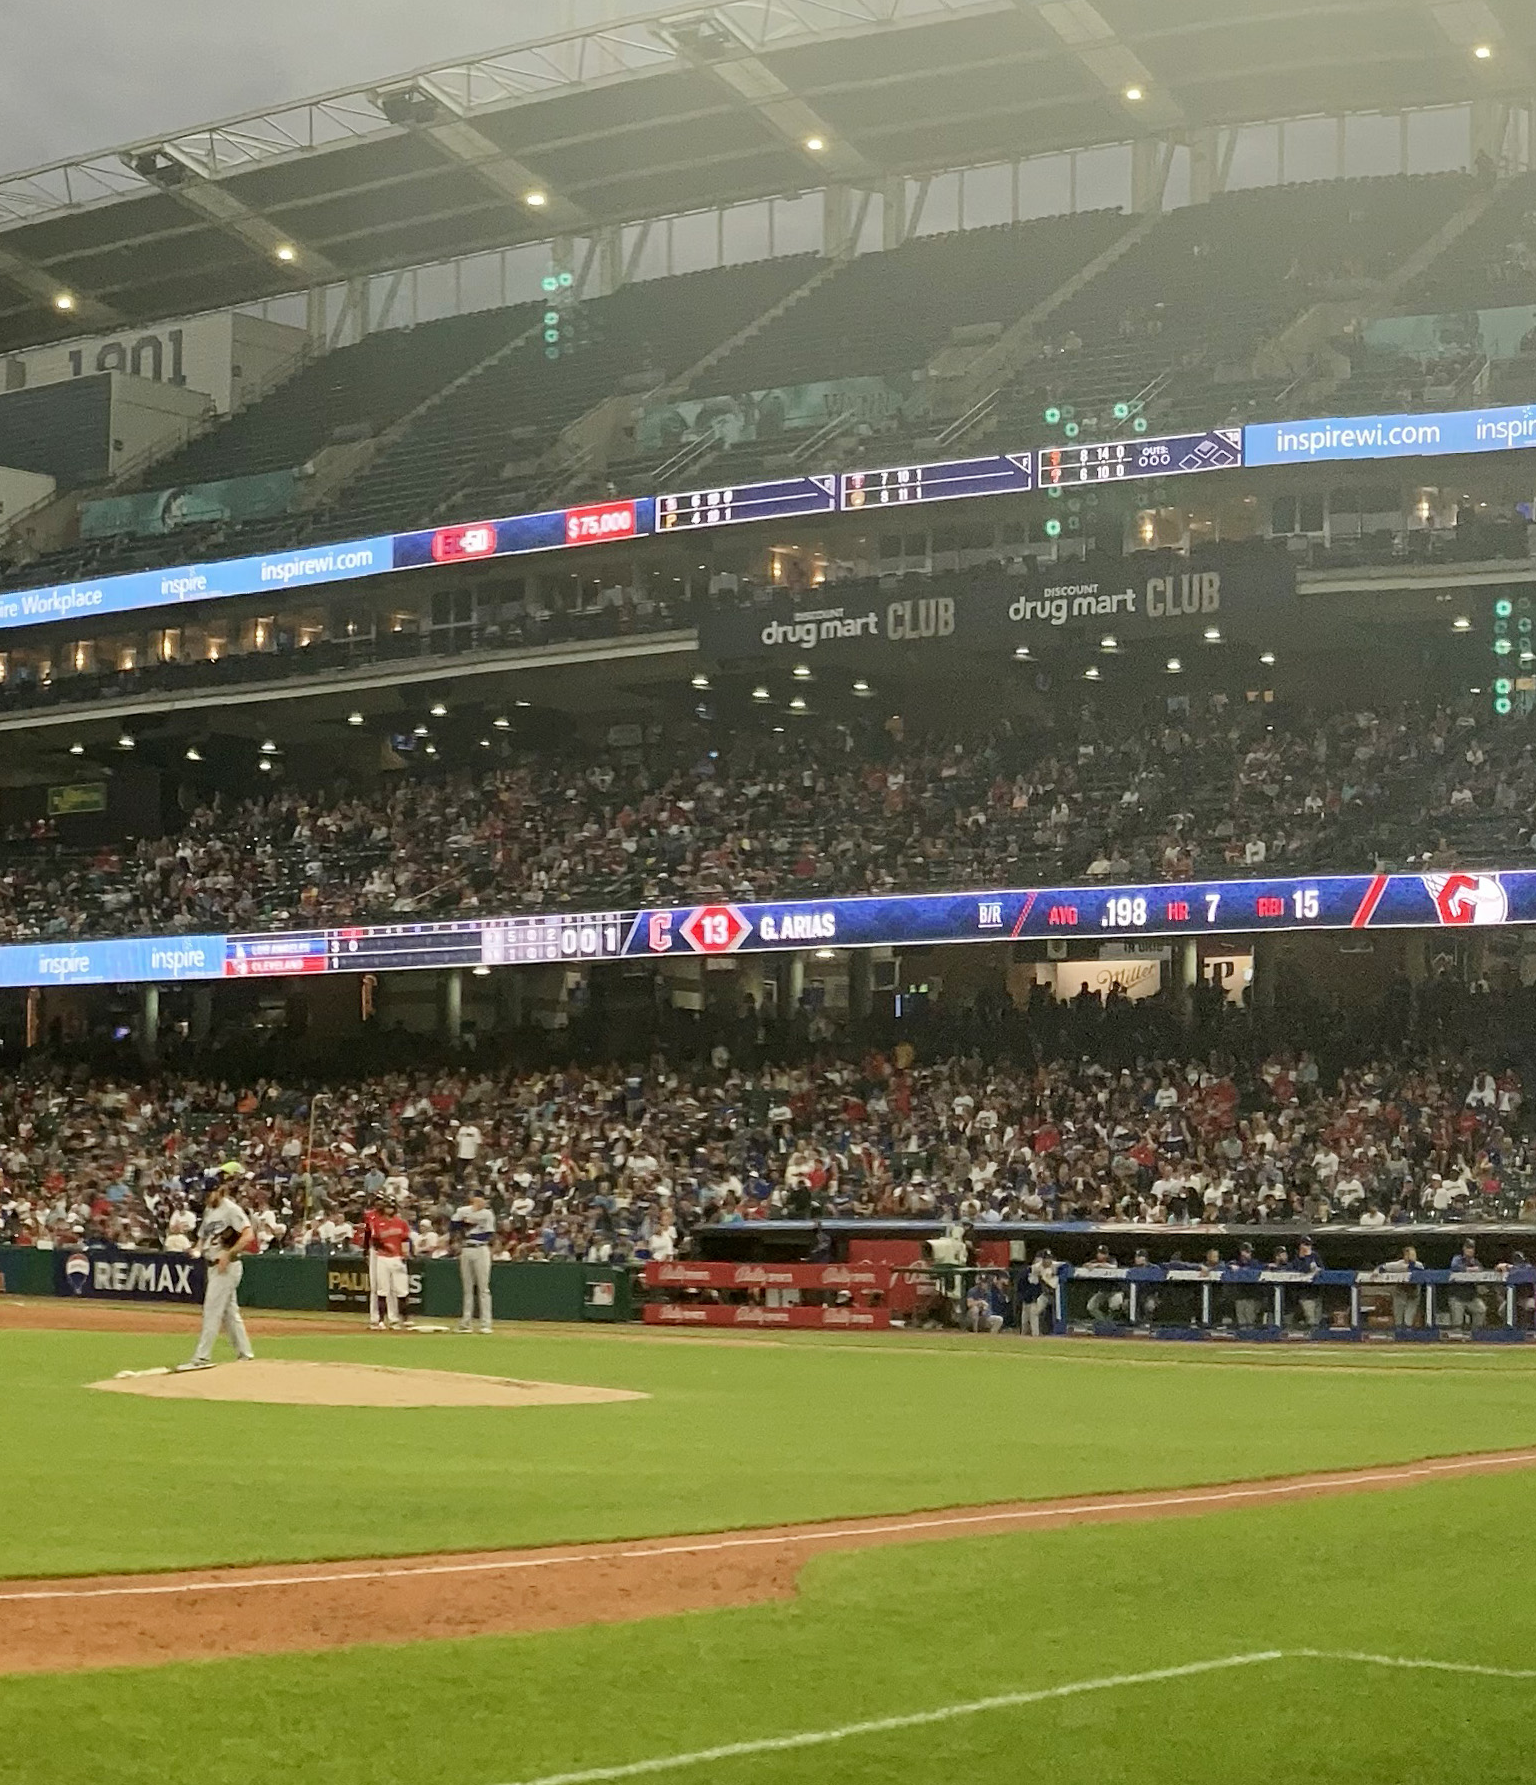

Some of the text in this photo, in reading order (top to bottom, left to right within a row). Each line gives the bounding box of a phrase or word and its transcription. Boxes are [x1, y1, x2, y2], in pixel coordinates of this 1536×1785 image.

[1276, 422, 1441, 456] inspirewi.com
[567, 510, 631, 538] $75,000
[20, 587, 104, 616] Workplace
[160, 571, 208, 599] inspire
[260, 548, 374, 583] inspirewi.com
[1008, 572, 1221, 626] drug mart CLUB
[1043, 583, 1099, 598] DISCOUNT
[761, 597, 956, 650] drug mart CLUB
[701, 890, 1320, 944] 13 ARIAS .198 7 15
[150, 945, 206, 978] inspire
[251, 958, 304, 973] CLEVELAND
[1096, 962, 1157, 991] Miller
[93, 1260, 193, 1295] RE/MAX
